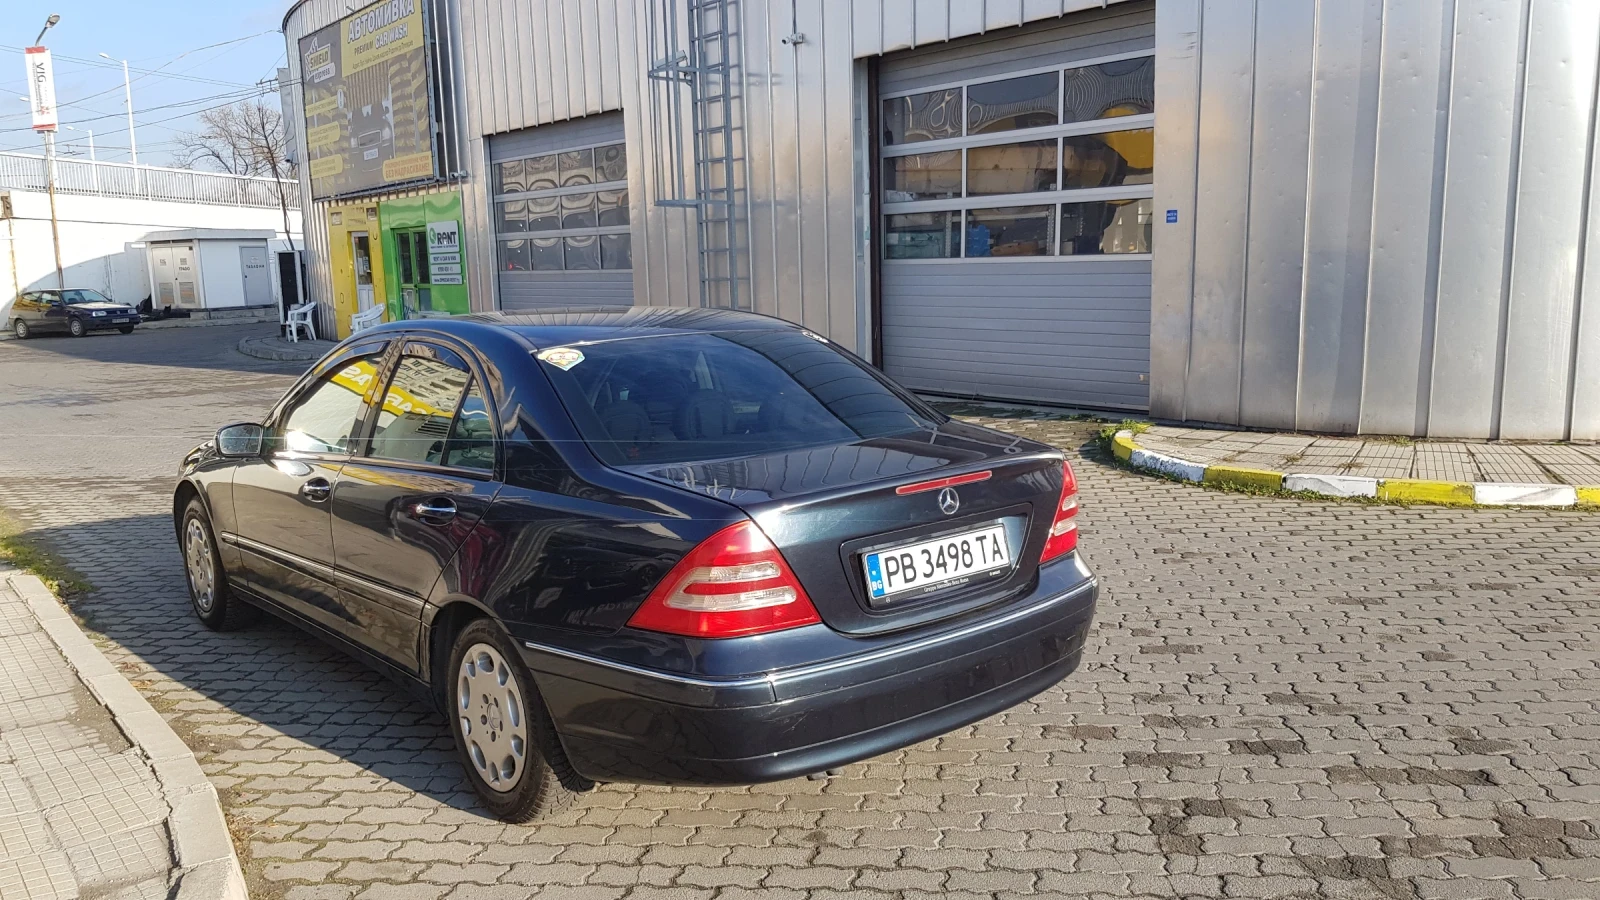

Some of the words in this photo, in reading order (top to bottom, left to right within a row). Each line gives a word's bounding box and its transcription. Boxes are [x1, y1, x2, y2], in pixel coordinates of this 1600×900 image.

[347, 0, 415, 44] АВТОМИВКА
[375, 31, 388, 49] CAR
[389, 22, 408, 43] WASH
[310, 50, 329, 68] SHIELD
[36, 62, 46, 83] VIG
[884, 553, 917, 588] PB
[921, 541, 974, 579] 3498
[976, 533, 1004, 565] TA
[871, 580, 883, 591] BG
